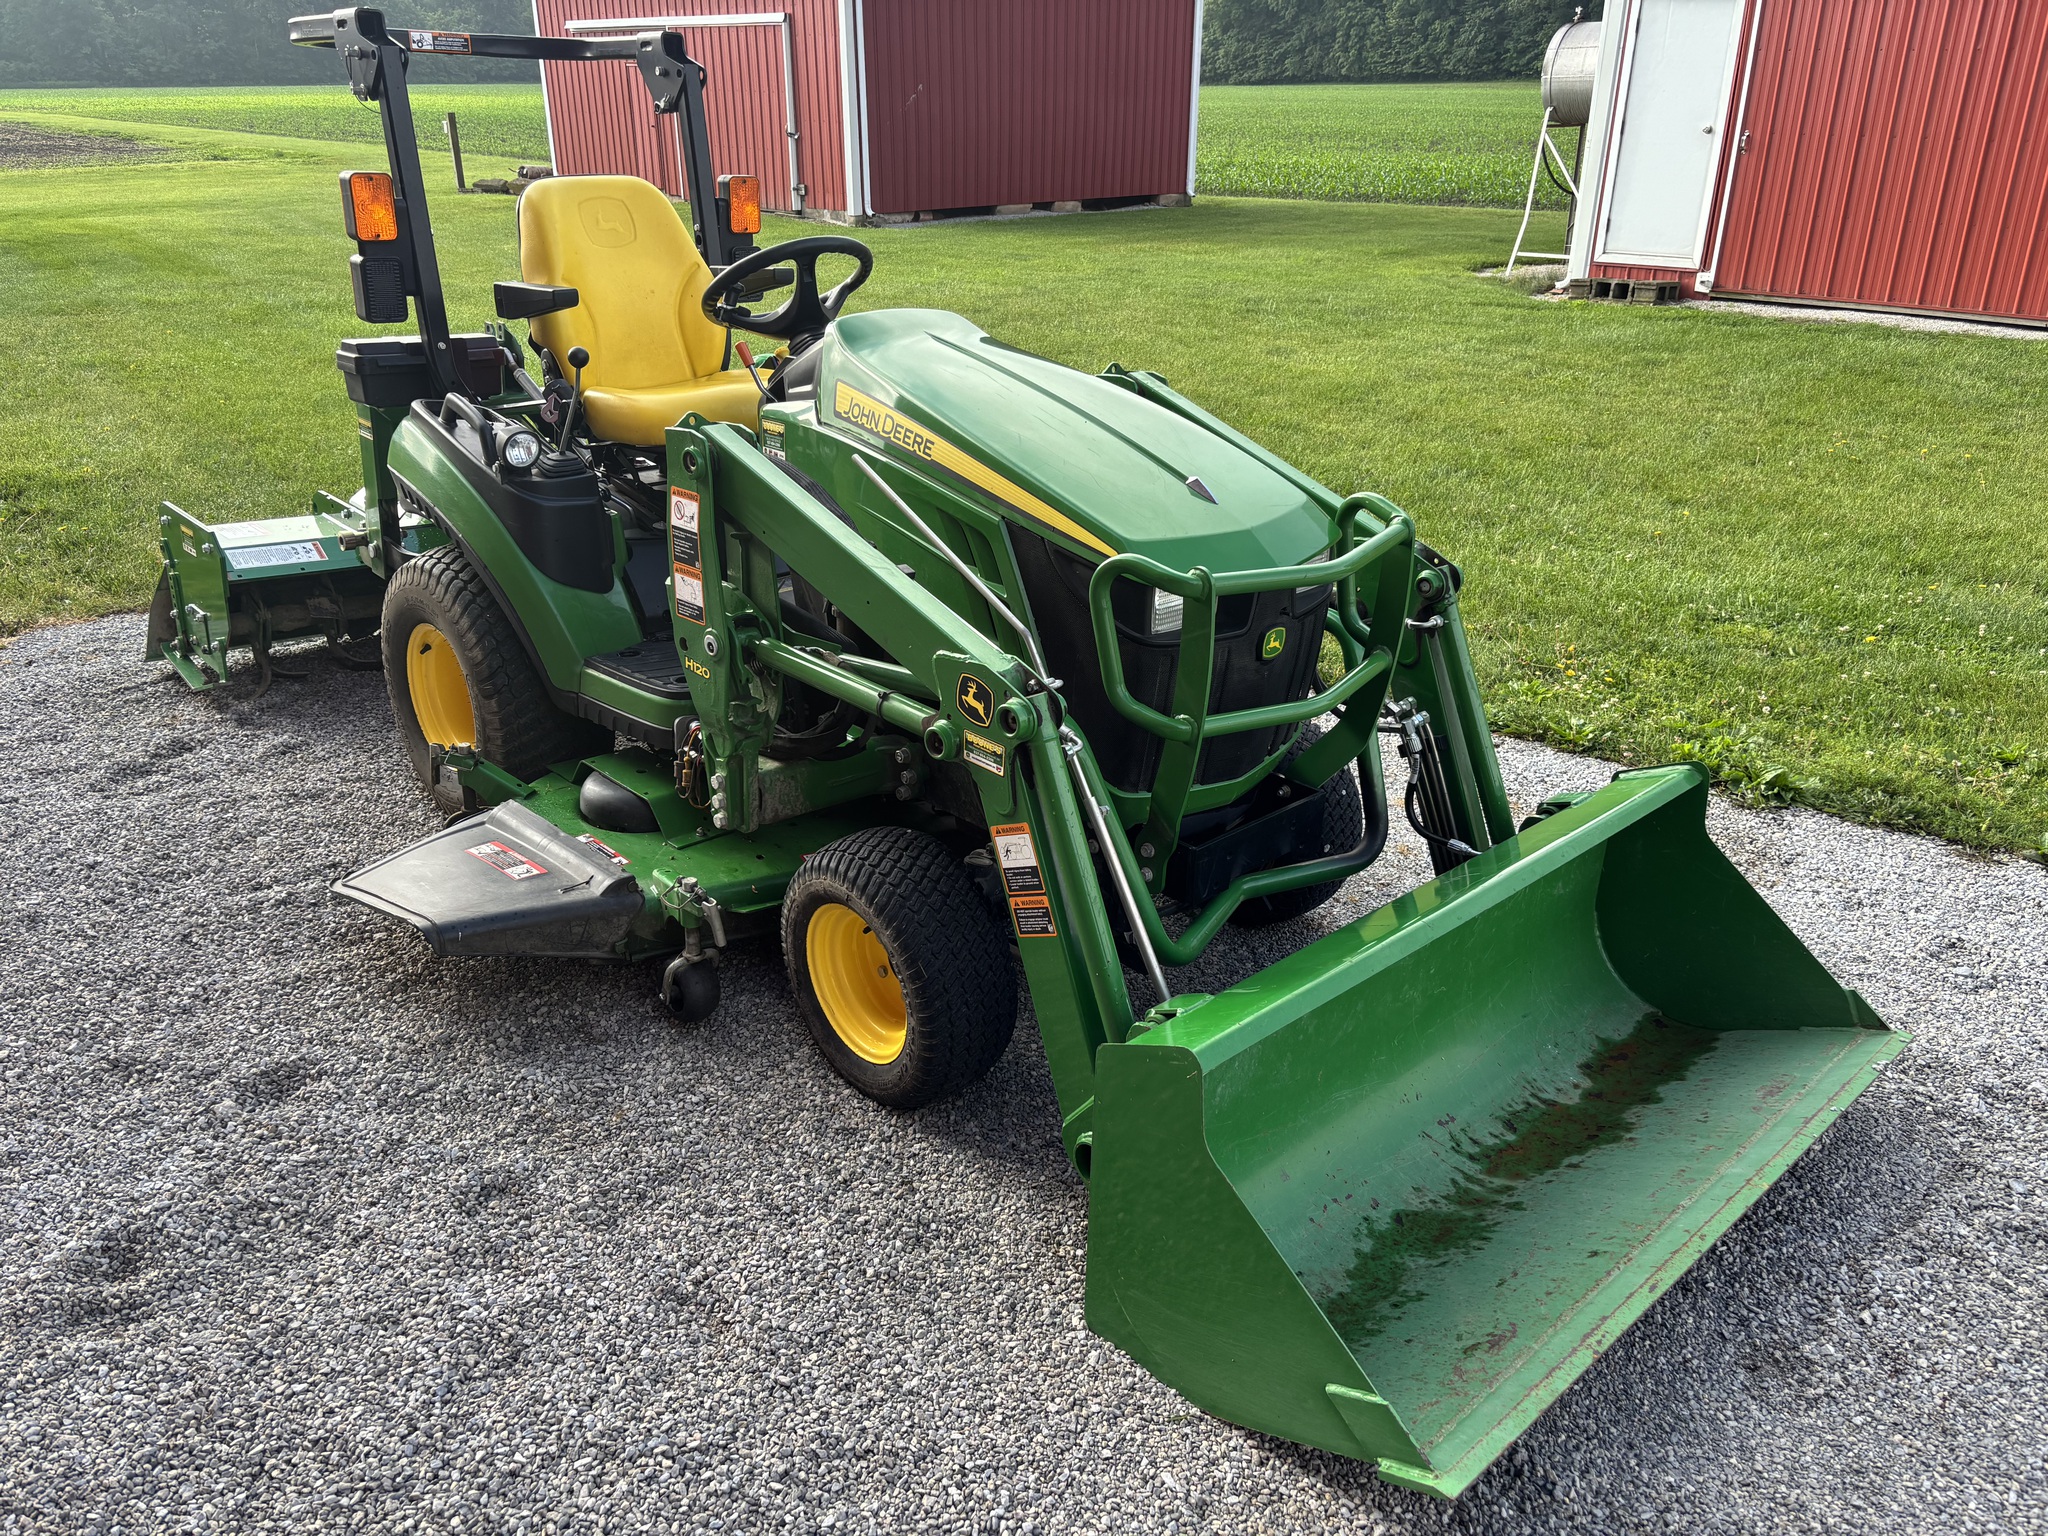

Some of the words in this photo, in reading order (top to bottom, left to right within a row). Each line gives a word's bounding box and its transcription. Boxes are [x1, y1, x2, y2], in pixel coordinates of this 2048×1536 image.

[843, 396, 881, 431] JOHN
[881, 413, 935, 458] DEERE
[677, 488, 699, 502] WARNING
[679, 567, 701, 580] WARNING
[685, 656, 710, 679] H120
[1001, 825, 1026, 834] WARNING
[1020, 899, 1045, 907] WARNING
